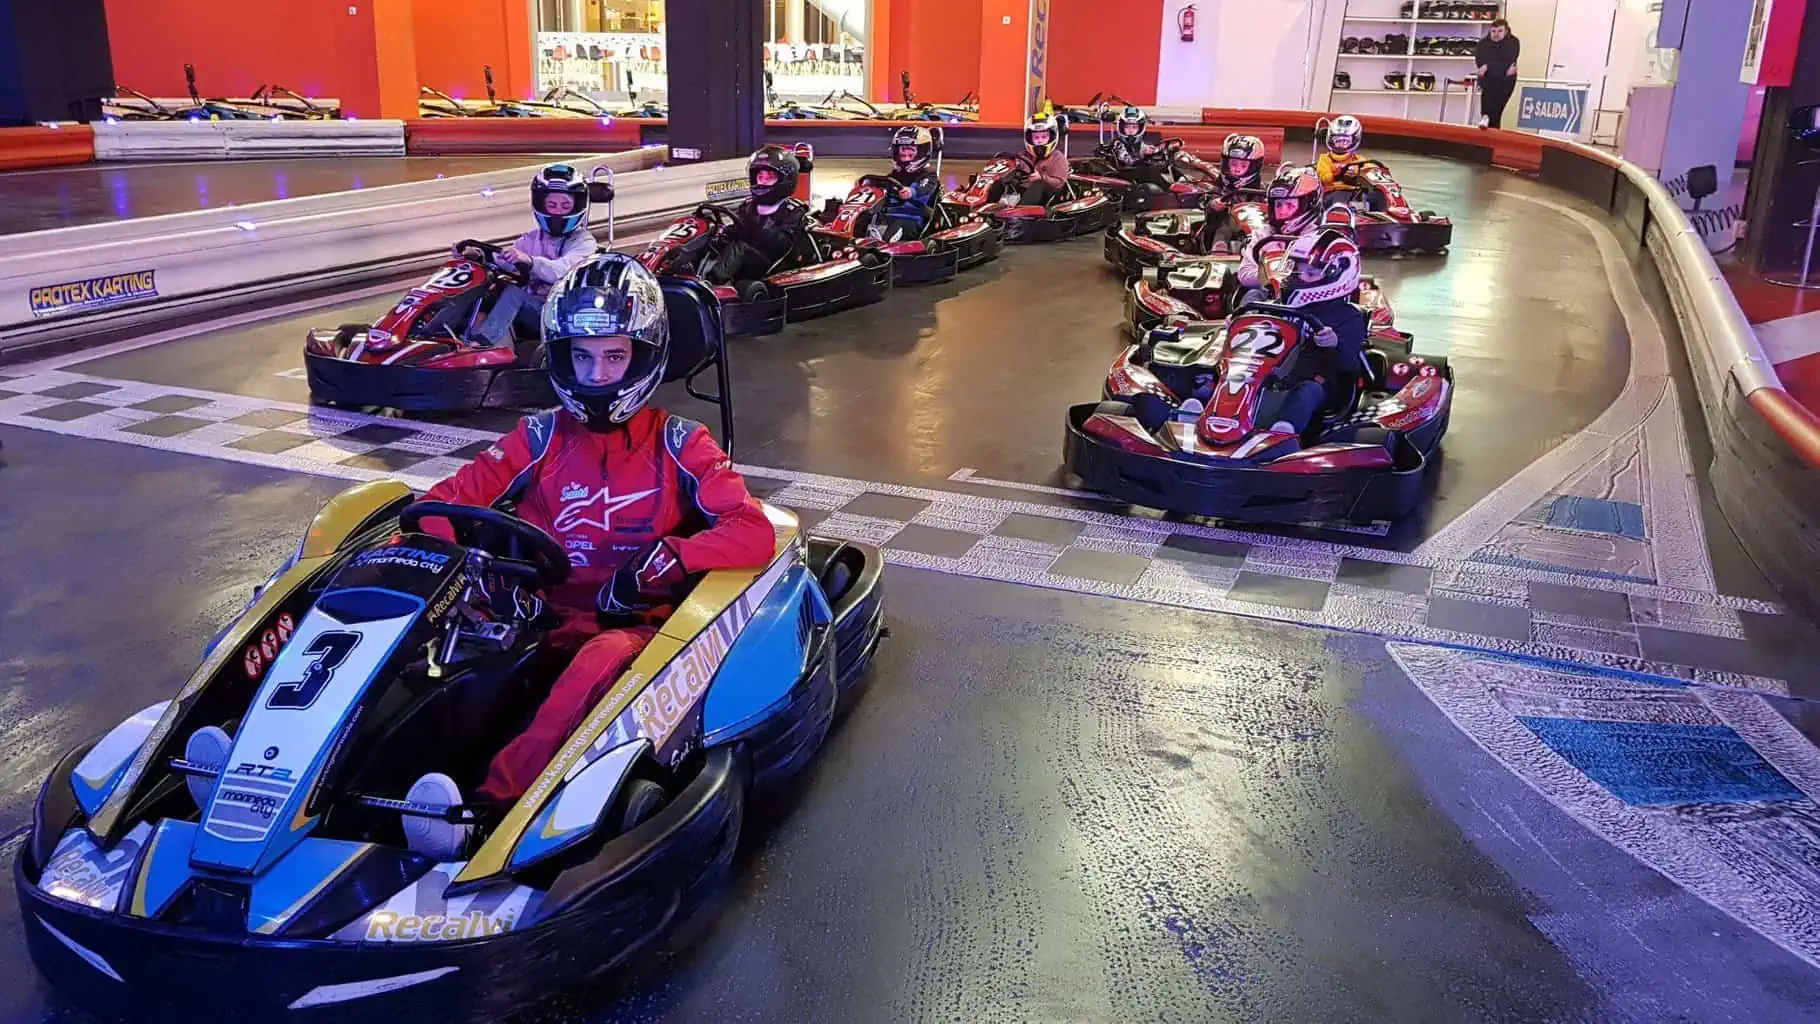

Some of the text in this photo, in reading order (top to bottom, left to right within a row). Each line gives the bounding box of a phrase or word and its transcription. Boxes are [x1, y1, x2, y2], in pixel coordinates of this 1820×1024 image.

[1534, 101, 1568, 119] SALIDA
[31, 281, 92, 305] PROTEX
[92, 271, 153, 297] KARTING
[433, 267, 474, 288] 29
[1230, 327, 1285, 358] 22
[564, 540, 595, 550] OPEL
[265, 629, 363, 710] 3
[631, 628, 726, 747] Recalvi
[250, 804, 275, 819] city
[365, 910, 514, 941] Recalvi
